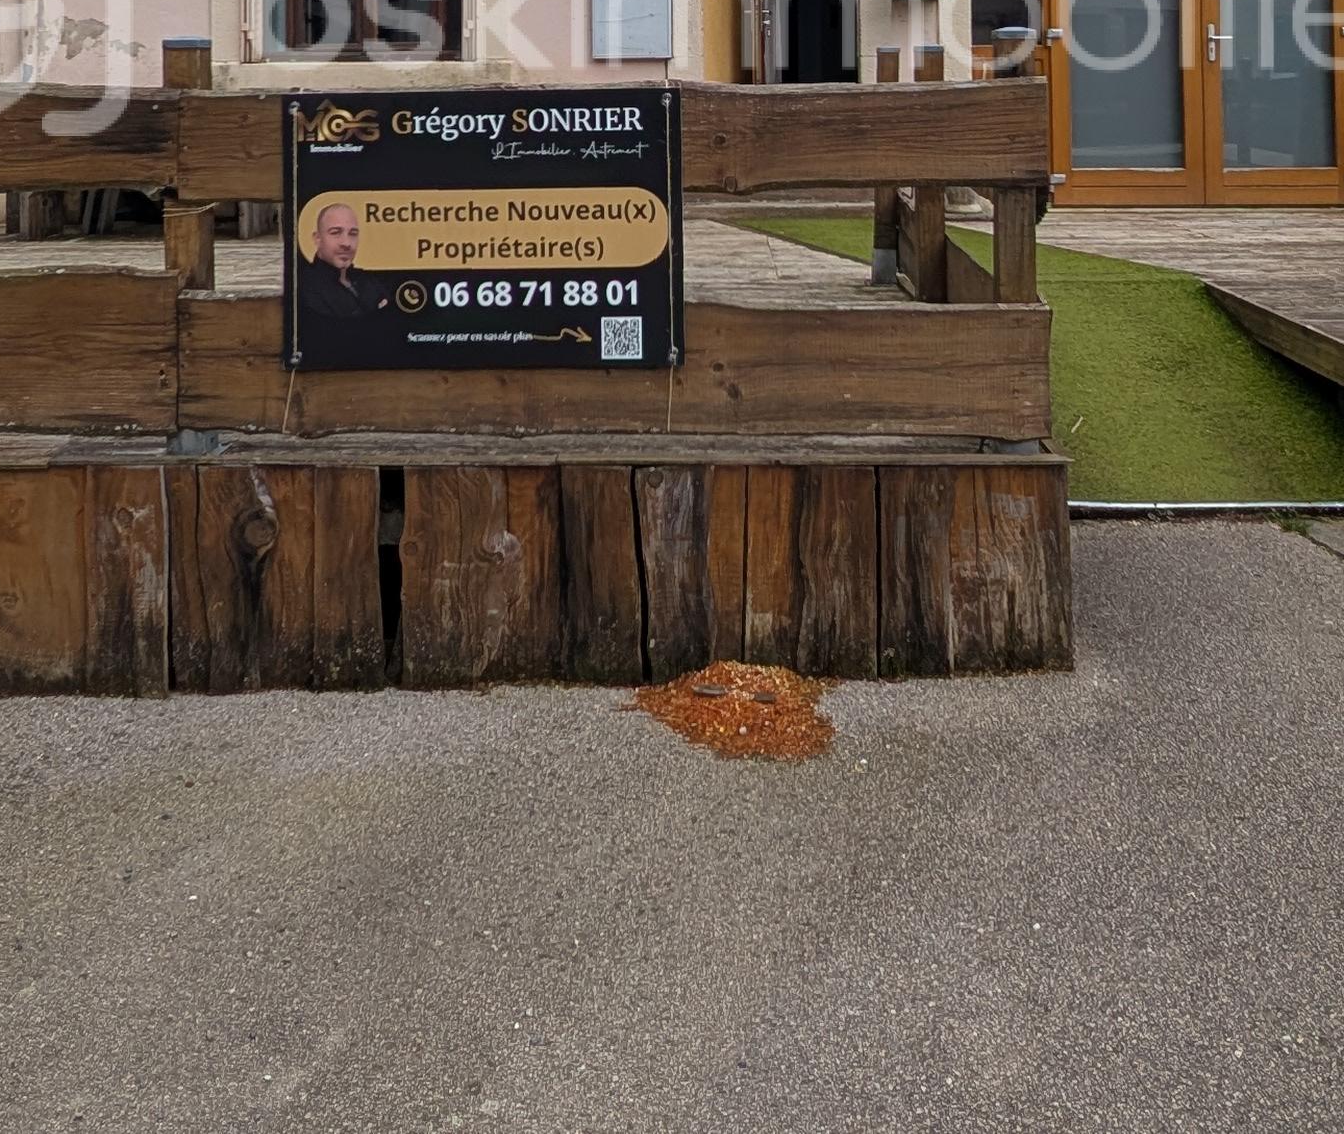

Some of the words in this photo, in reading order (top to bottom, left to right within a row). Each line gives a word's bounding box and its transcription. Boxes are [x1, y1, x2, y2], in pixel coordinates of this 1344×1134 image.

[392, 107, 506, 142] Grégory
[512, 107, 643, 133] SONRIER
[365, 201, 499, 223] Recherche
[507, 199, 656, 224] Nouveau(x)
[417, 236, 604, 264] Propriétaire(s)
[434, 281, 470, 308] 06
[476, 280, 512, 307] 68
[519, 280, 552, 307] 71
[563, 280, 598, 307] 88
[605, 280, 638, 306] 01
